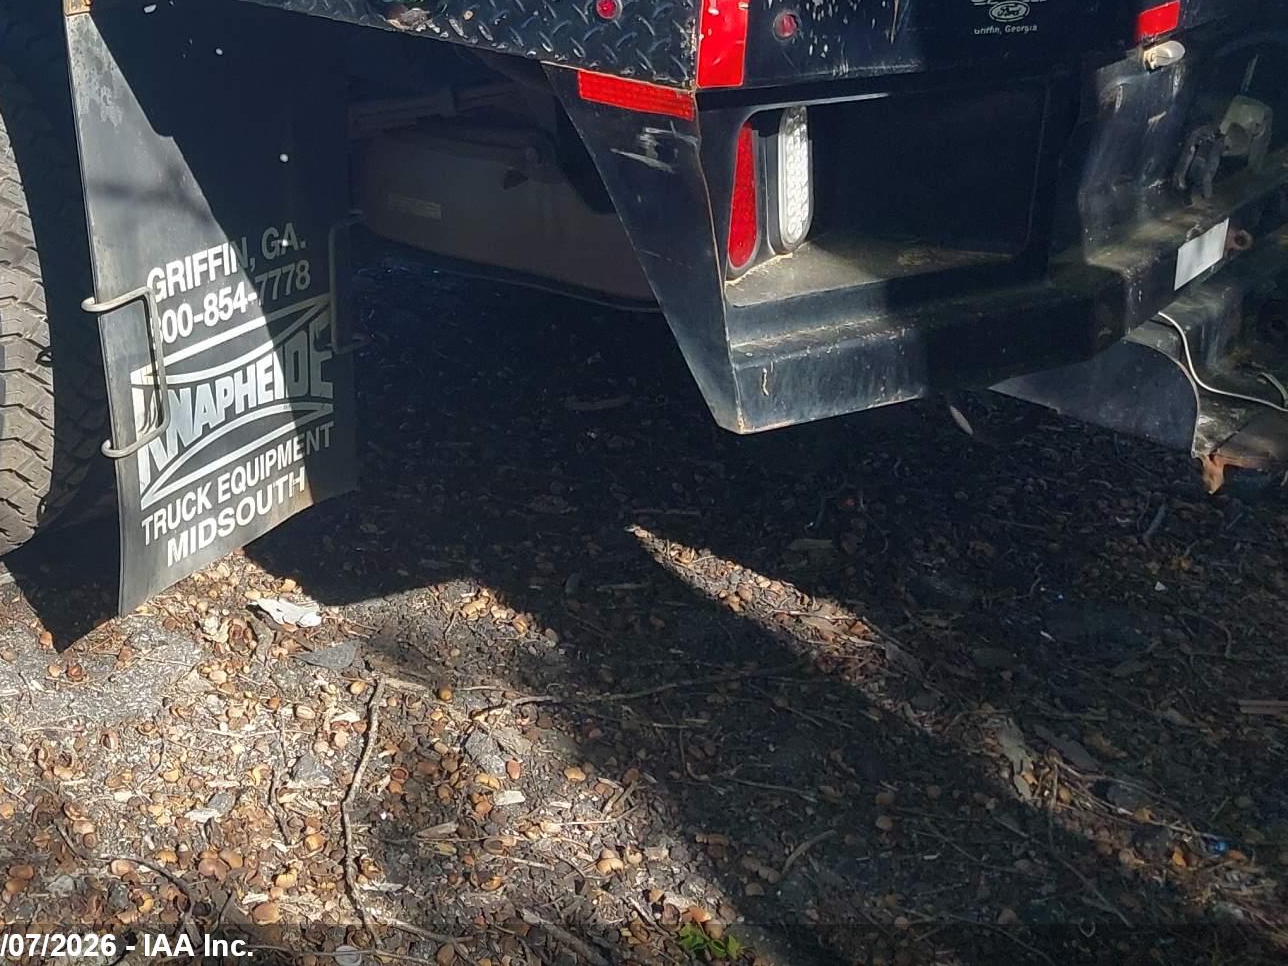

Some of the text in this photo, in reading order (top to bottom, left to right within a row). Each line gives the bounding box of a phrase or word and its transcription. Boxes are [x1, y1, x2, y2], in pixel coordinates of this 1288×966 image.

[146, 222, 307, 302] GRIFFIN, GA.
[142, 421, 335, 547] TRUCK EQUIPMENT
[167, 466, 306, 568] MIDSOUTH
